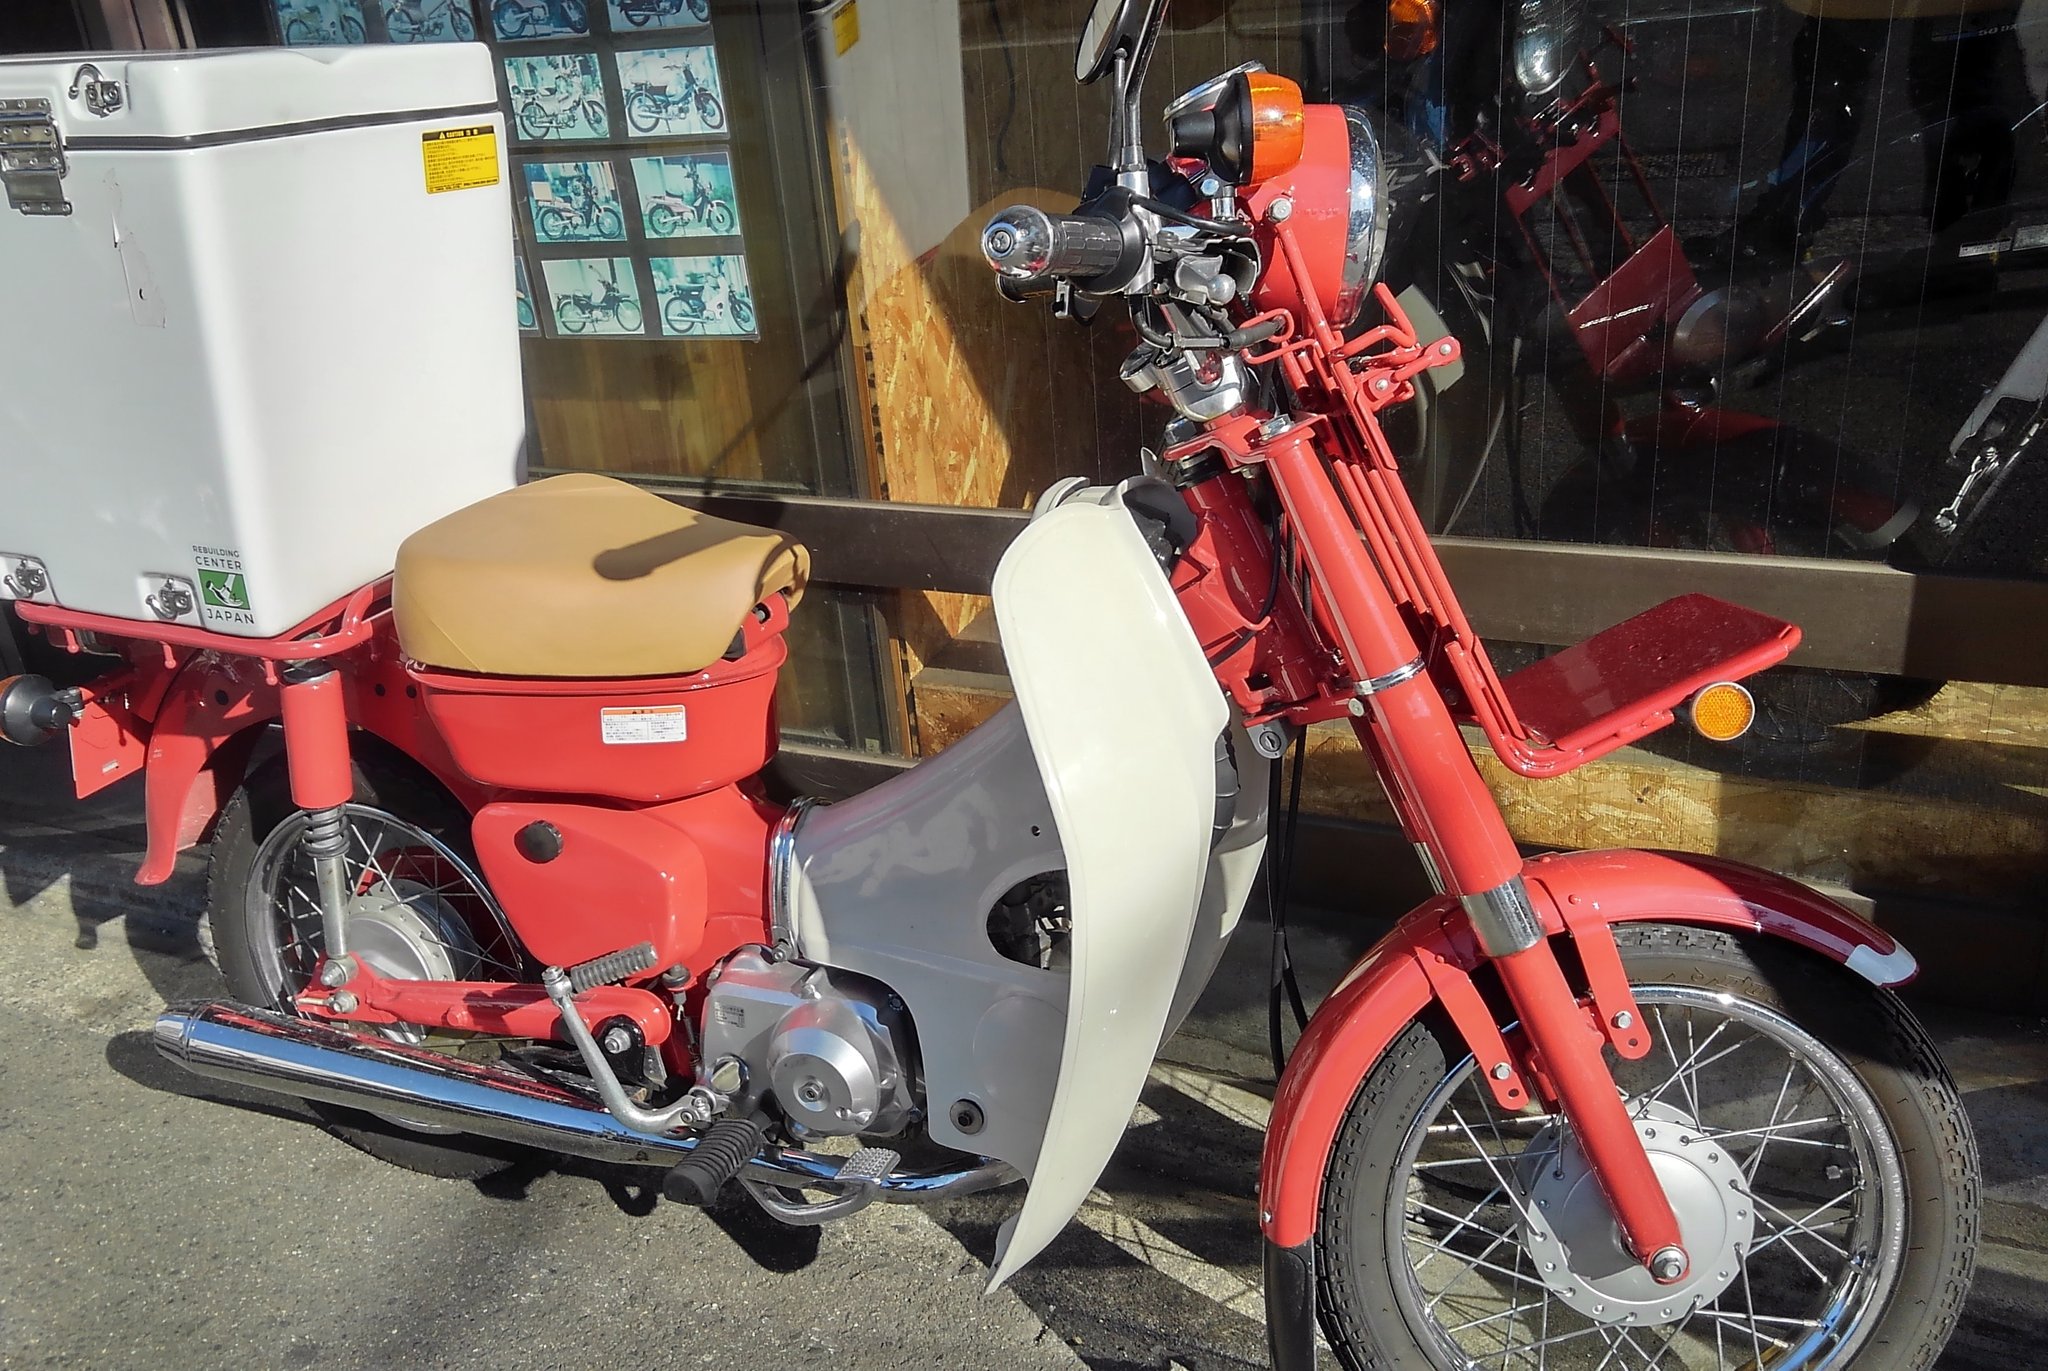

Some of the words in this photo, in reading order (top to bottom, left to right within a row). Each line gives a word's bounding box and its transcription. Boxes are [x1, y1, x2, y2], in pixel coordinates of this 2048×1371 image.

[192, 545, 240, 558] REBUILDING
[195, 556, 242, 570] CENTER
[206, 608, 255, 624] JAPAN
